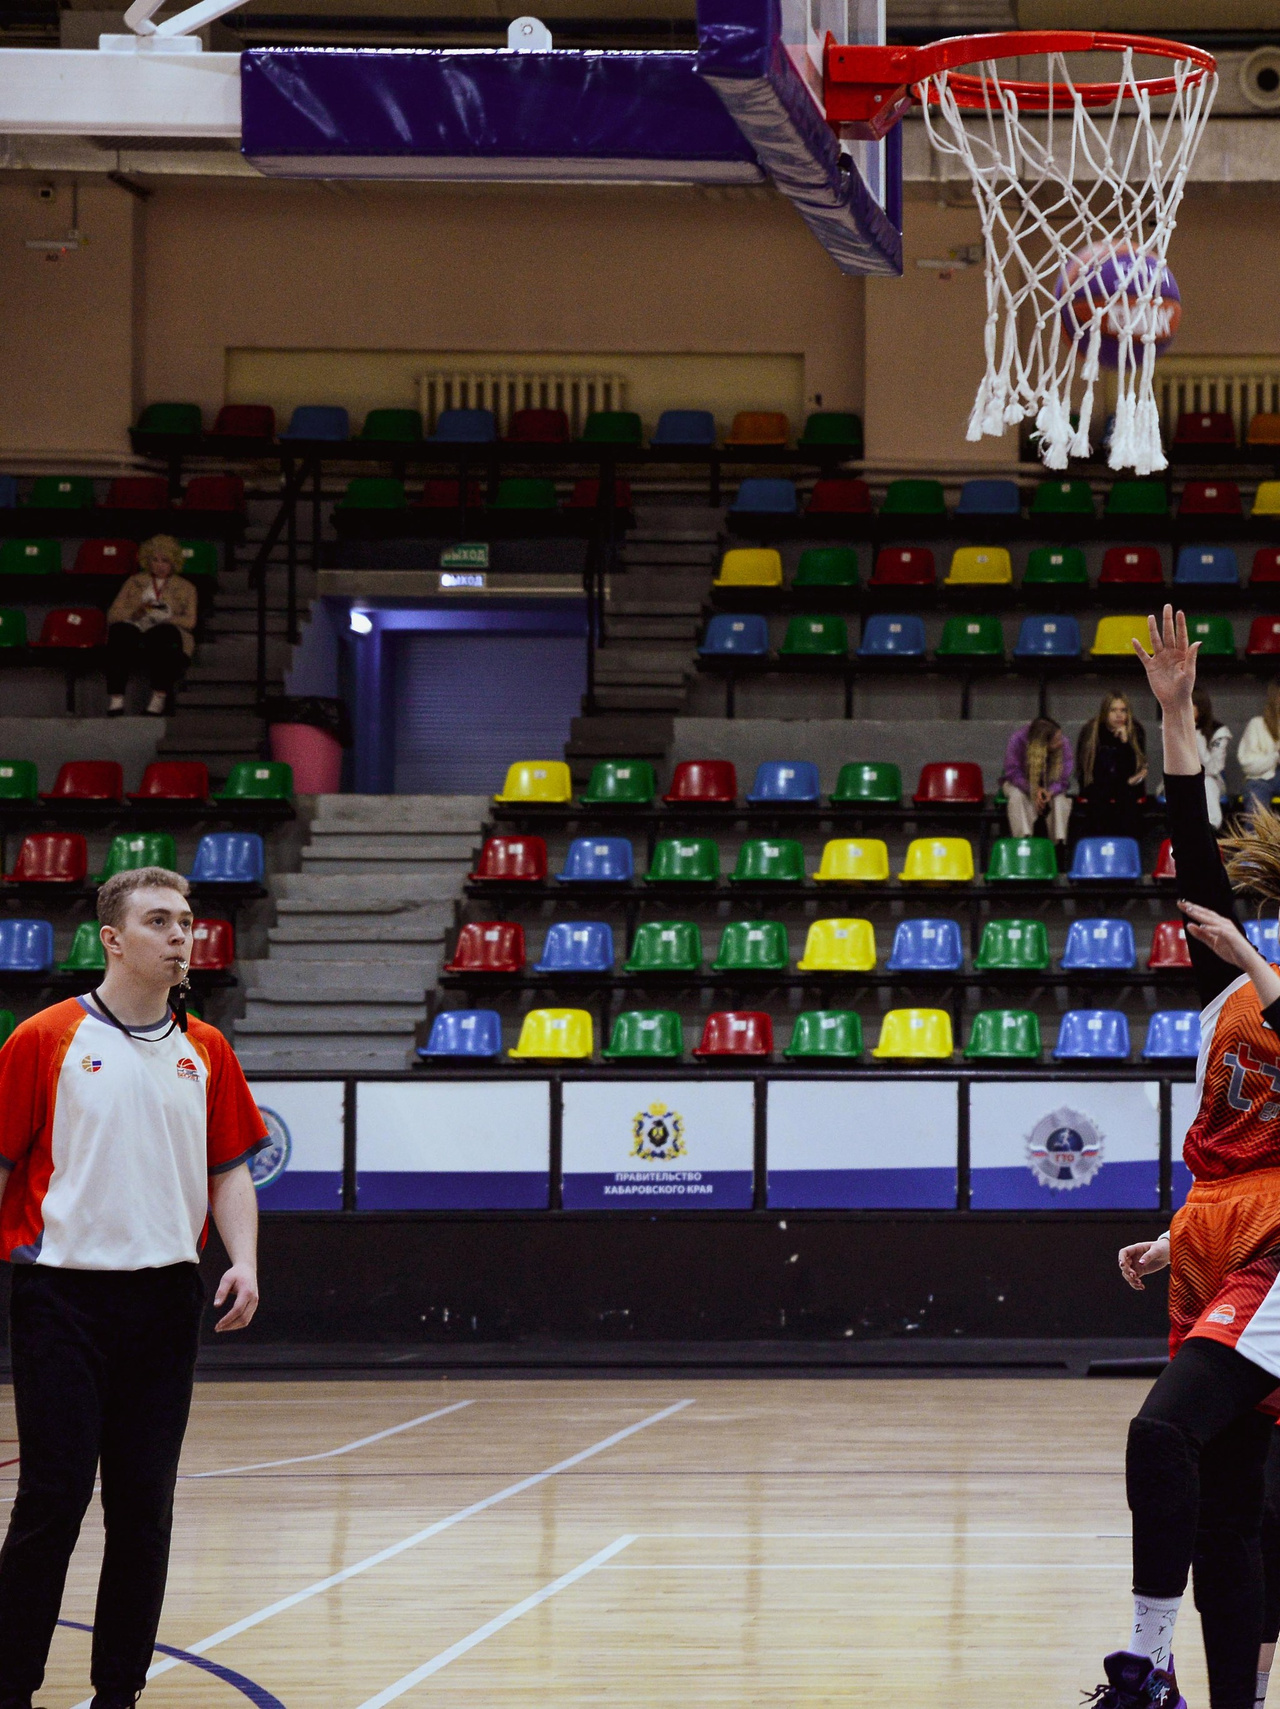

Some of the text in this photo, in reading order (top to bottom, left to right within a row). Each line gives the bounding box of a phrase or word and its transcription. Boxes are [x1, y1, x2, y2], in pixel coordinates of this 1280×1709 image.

[615, 1172, 702, 1182] ПРАВИТЕЛЬСТВО
[604, 1184, 713, 1195] ХАБАРОВСКОГО КРАЯ
